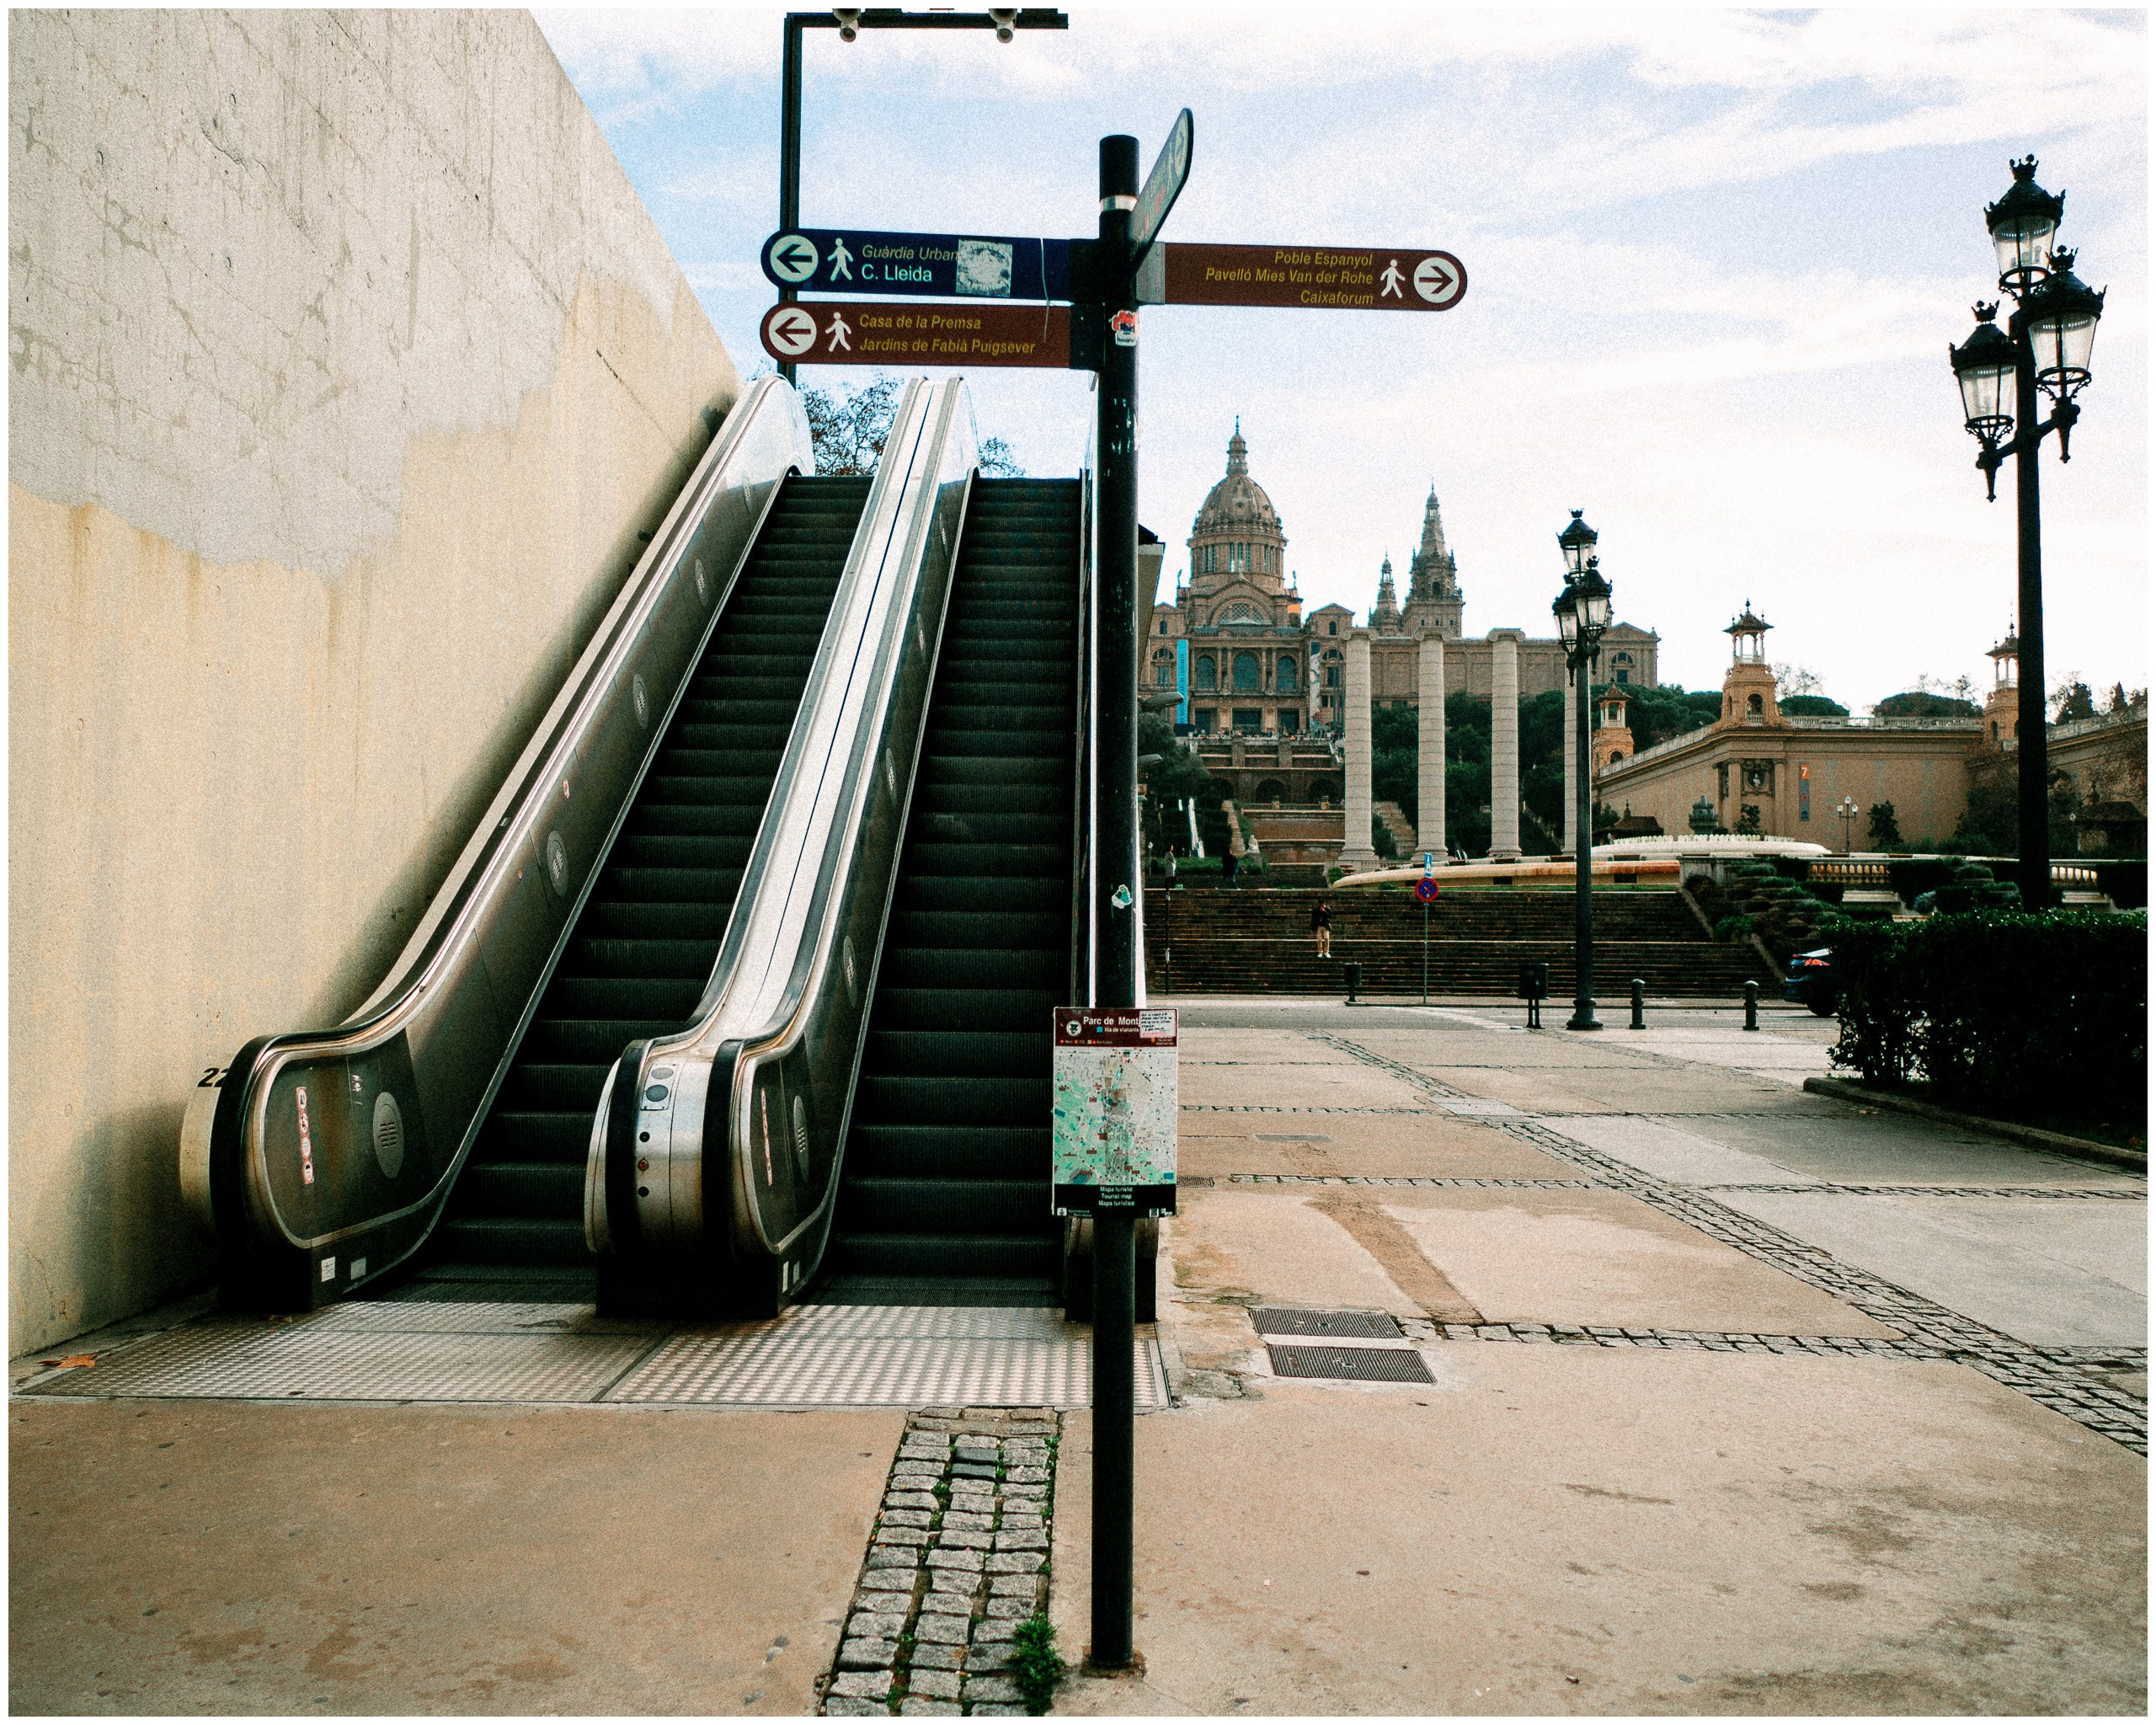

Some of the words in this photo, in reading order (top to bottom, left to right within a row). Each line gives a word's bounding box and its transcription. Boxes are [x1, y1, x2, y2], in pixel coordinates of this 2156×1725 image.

[862, 244, 915, 259] Guàrdia
[919, 247, 959, 261] Urban
[1275, 251, 1311, 264] Poble
[1315, 252, 1373, 270] Espanyol
[862, 264, 878, 280] C.
[884, 264, 932, 282] Lleida
[1206, 268, 1251, 281] Pavelló
[1256, 269, 1285, 282] Mies
[1289, 270, 1312, 283] Van
[1316, 270, 1337, 284] der
[1341, 270, 1374, 285] Rohe
[1300, 290, 1374, 305] Caixaforum
[860, 314, 893, 328] Casa
[896, 315, 912, 328] de
[916, 315, 927, 328] la
[931, 315, 981, 329] Premsa
[860, 338, 908, 352] Jardins
[912, 339, 928, 352] de
[932, 339, 968, 353] Fabià
[971, 339, 1036, 356] Puigsever
[1801, 766, 1808, 777] 7
[1083, 1016, 1102, 1025] Parc
[1103, 1016, 1114, 1025] de
